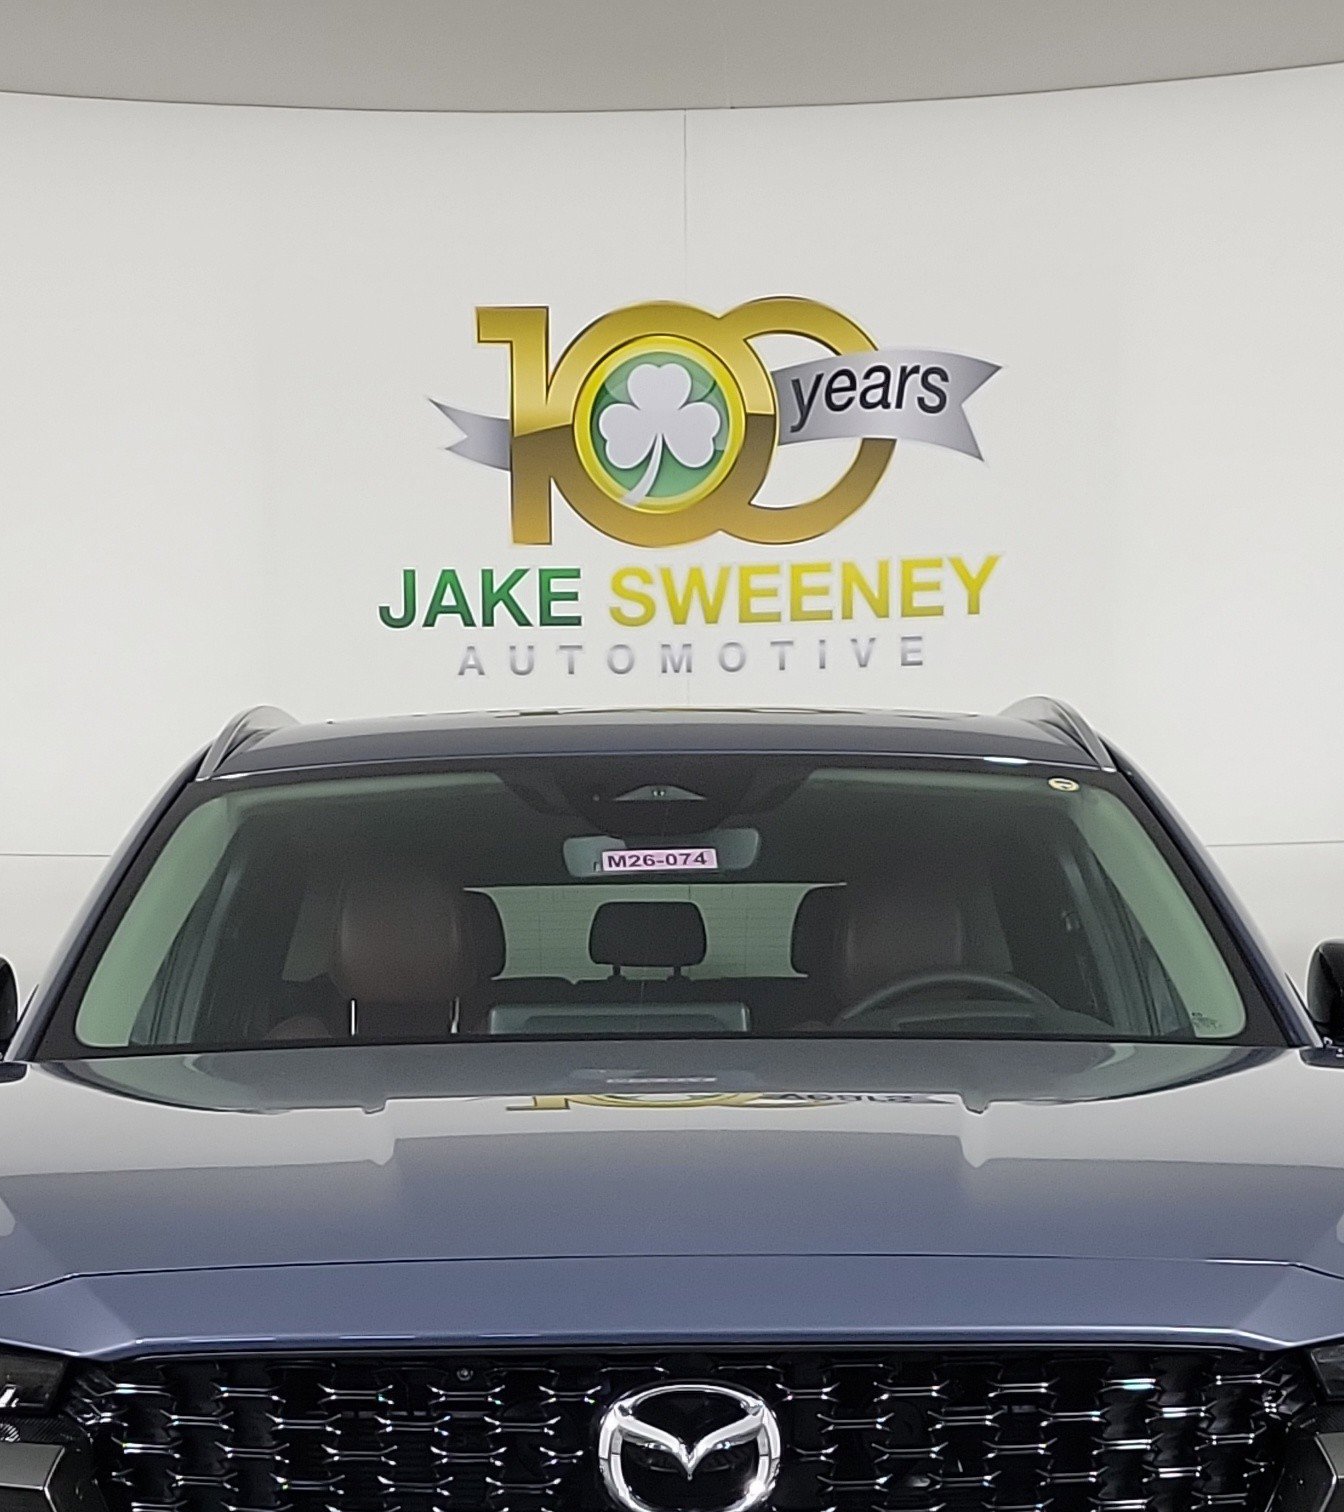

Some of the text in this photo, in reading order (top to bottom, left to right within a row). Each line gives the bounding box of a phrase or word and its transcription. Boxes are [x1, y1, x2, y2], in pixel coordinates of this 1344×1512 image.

[475, 297, 897, 547] 100
[789, 364, 950, 434] years
[378, 555, 1000, 629] JAKE SWEENEY
[457, 635, 925, 677] AUTOMOTIVE
[607, 852, 707, 868] M26-074
